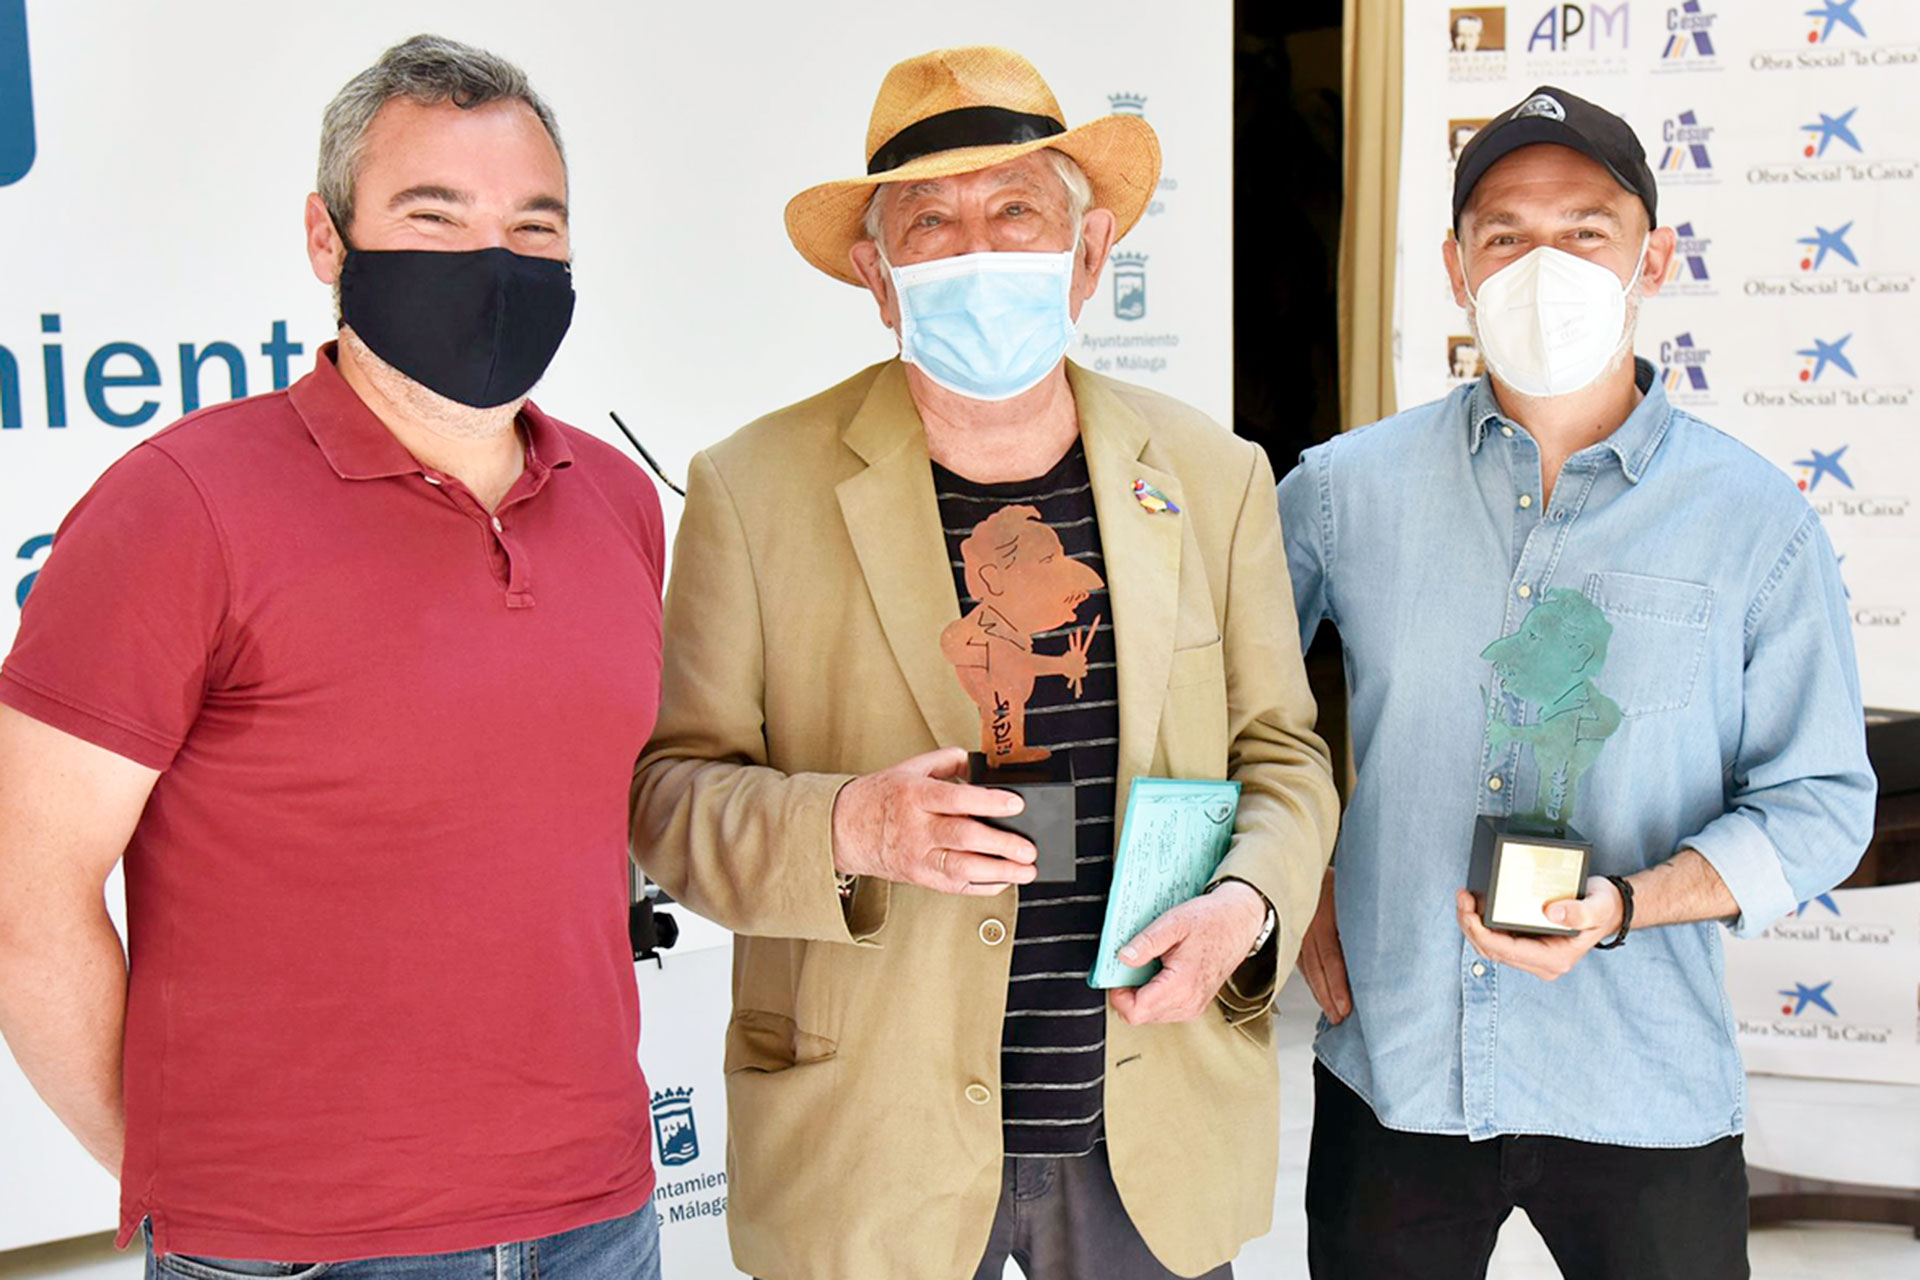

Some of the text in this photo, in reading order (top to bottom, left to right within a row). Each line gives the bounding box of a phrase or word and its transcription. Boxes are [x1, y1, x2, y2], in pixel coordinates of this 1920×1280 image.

[1527, 2, 1630, 52] APM
[1750, 54, 1792, 70] Obra
[1797, 51, 1845, 67] Social
[1747, 168, 1789, 183] Obra
[1793, 166, 1841, 181] Social
[1675, 238, 1712, 254] esur
[1743, 280, 1786, 296] Obra
[1790, 279, 1837, 295] Social
[1081, 333, 1179, 351] Ayuntamiento
[1093, 354, 1166, 373] de Málaga
[1743, 391, 1785, 407] Obra
[1789, 390, 1836, 406] Social
[1774, 926, 1820, 940] Social
[1772, 1023, 1818, 1038] Social
[652, 1171, 727, 1200] ntamien
